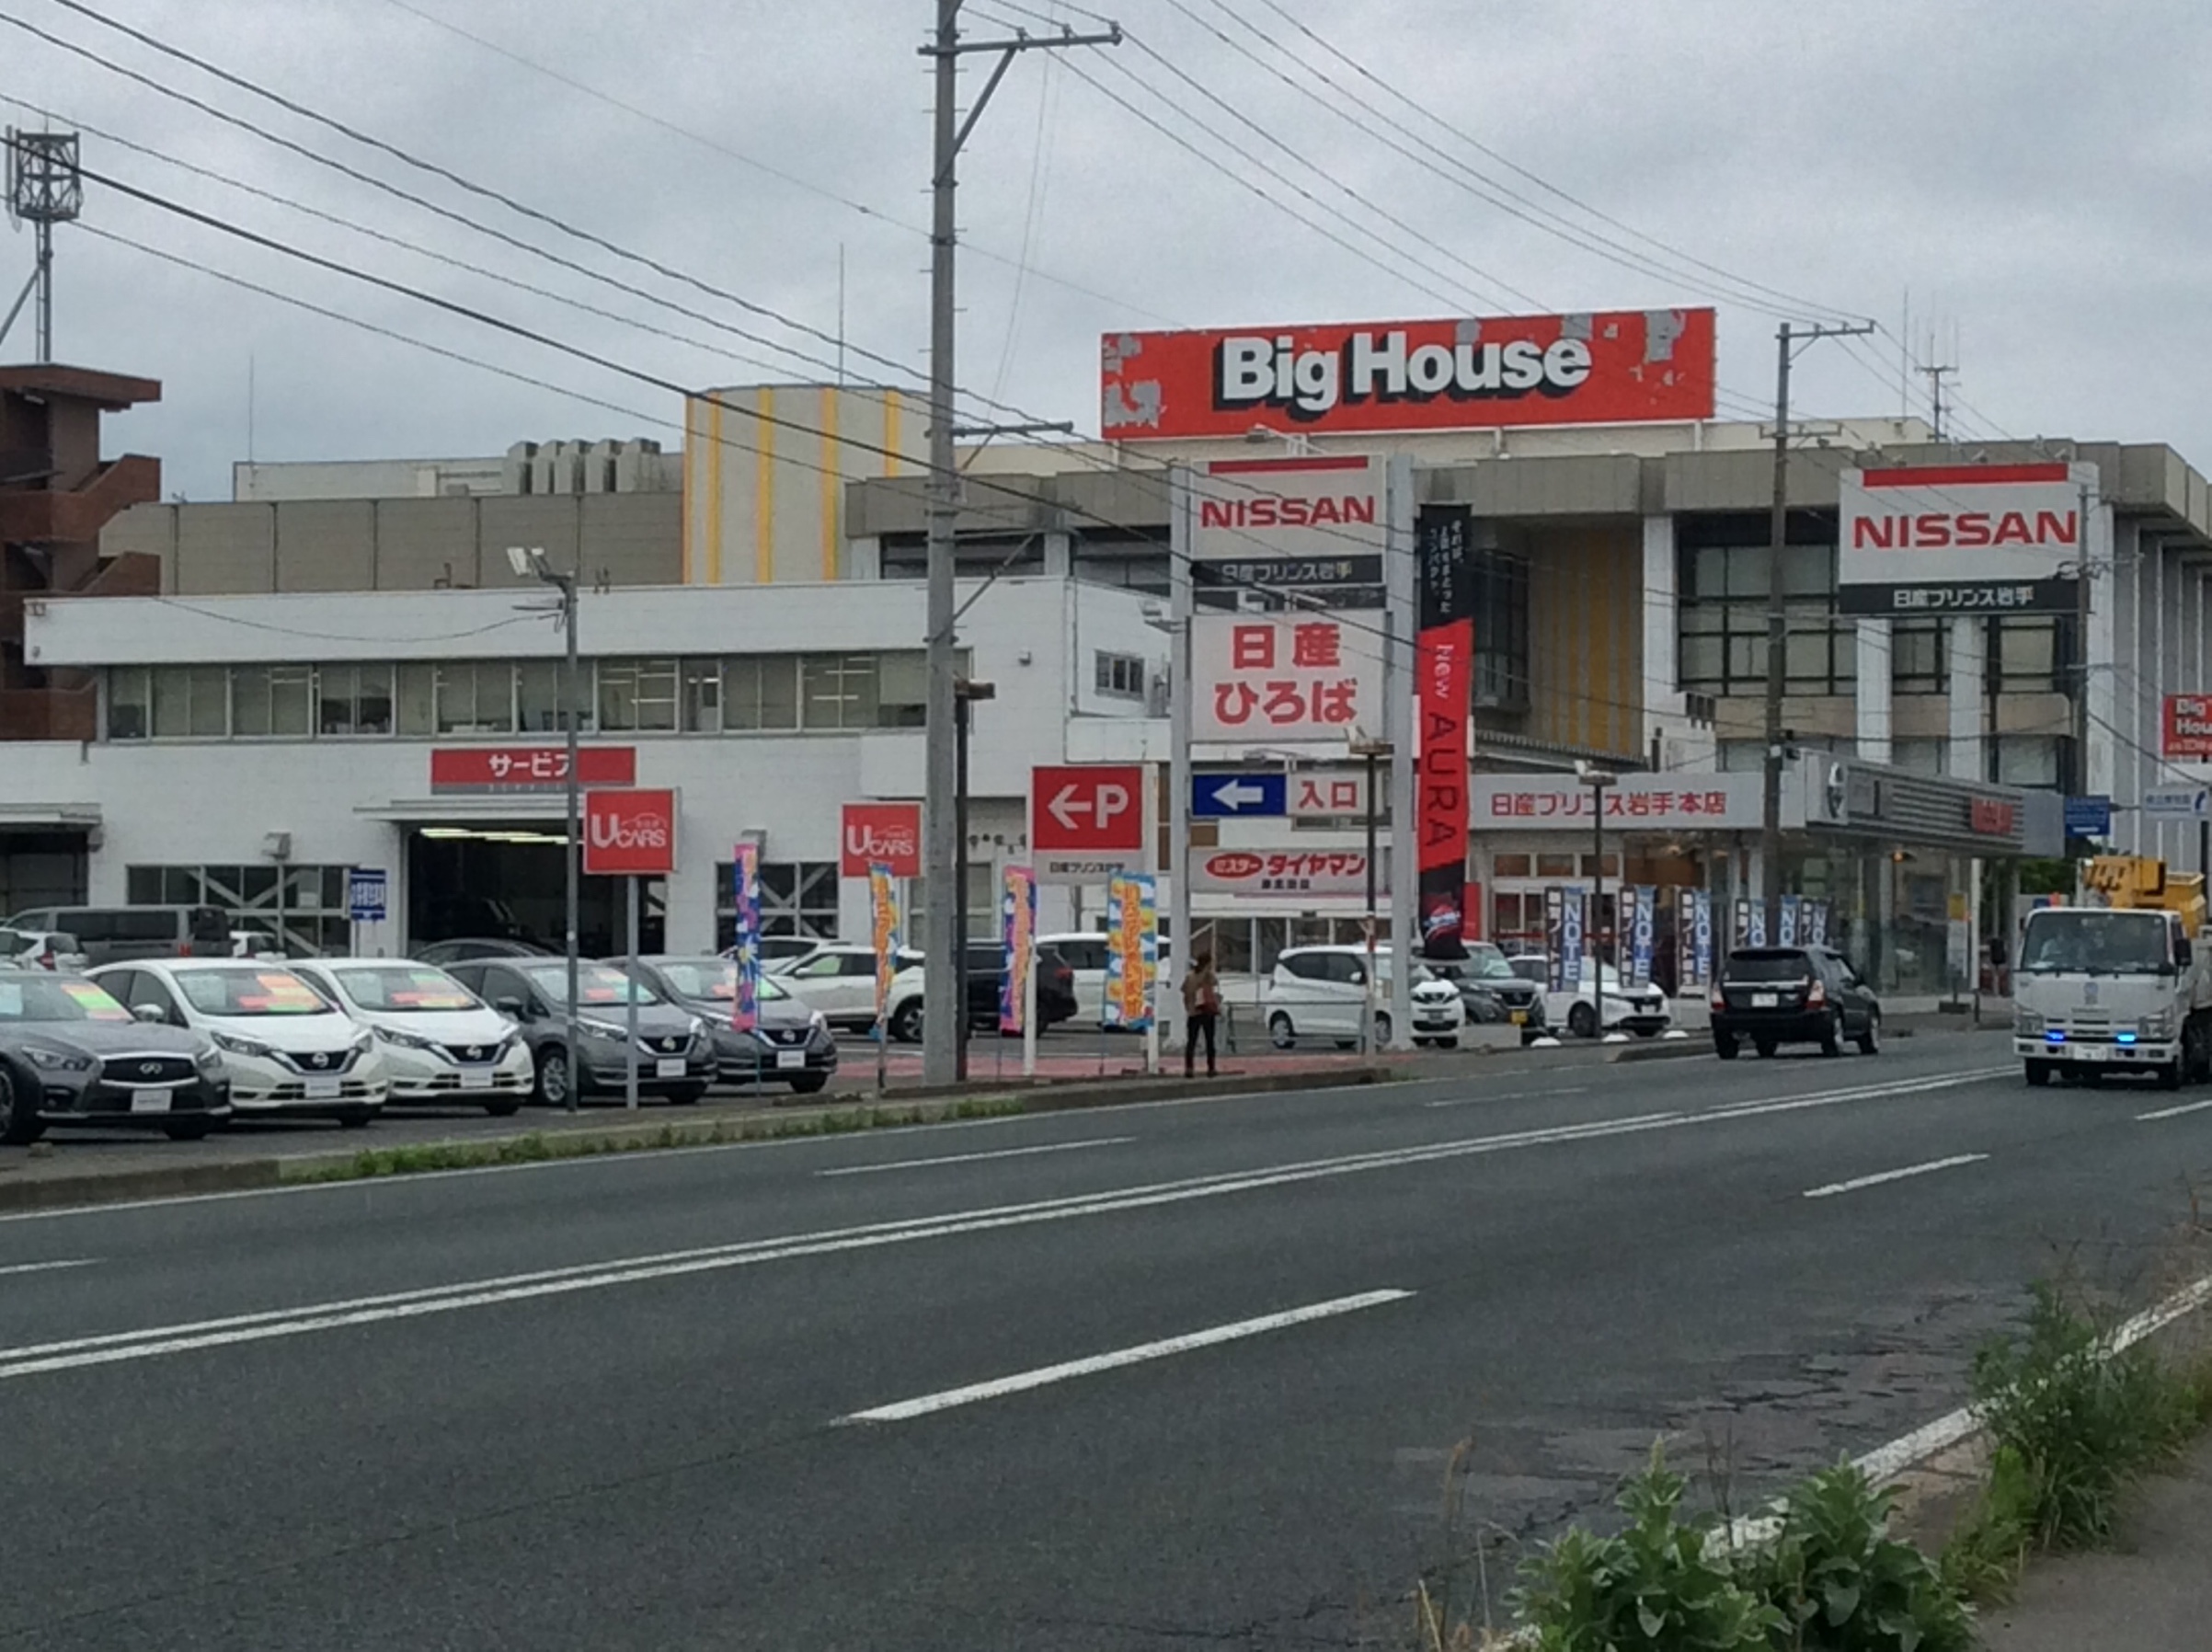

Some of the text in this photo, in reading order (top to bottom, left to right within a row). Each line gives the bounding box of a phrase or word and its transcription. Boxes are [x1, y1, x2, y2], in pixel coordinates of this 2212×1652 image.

[1223, 331, 1592, 411] Big House
[1201, 496, 1375, 528] NISSAN
[1852, 510, 2077, 548] NISSAN
[1893, 585, 2034, 608] 日産プリンス岩手
[1232, 622, 1341, 670] 日産
[1214, 677, 1358, 725] ひろば
[1298, 780, 1358, 809] 入口
[1425, 711, 1459, 848] AURA
[1095, 784, 1129, 830] P
[1491, 791, 1727, 817] 日産プリンス岩手本店
[1266, 854, 1367, 878] ダイヤマン
[1564, 902, 1582, 981] NOTE
[1634, 902, 1654, 978] NOTE
[1695, 903, 1712, 975] NOTE
[1750, 911, 1765, 948] NO
[1780, 909, 1795, 947] NO
